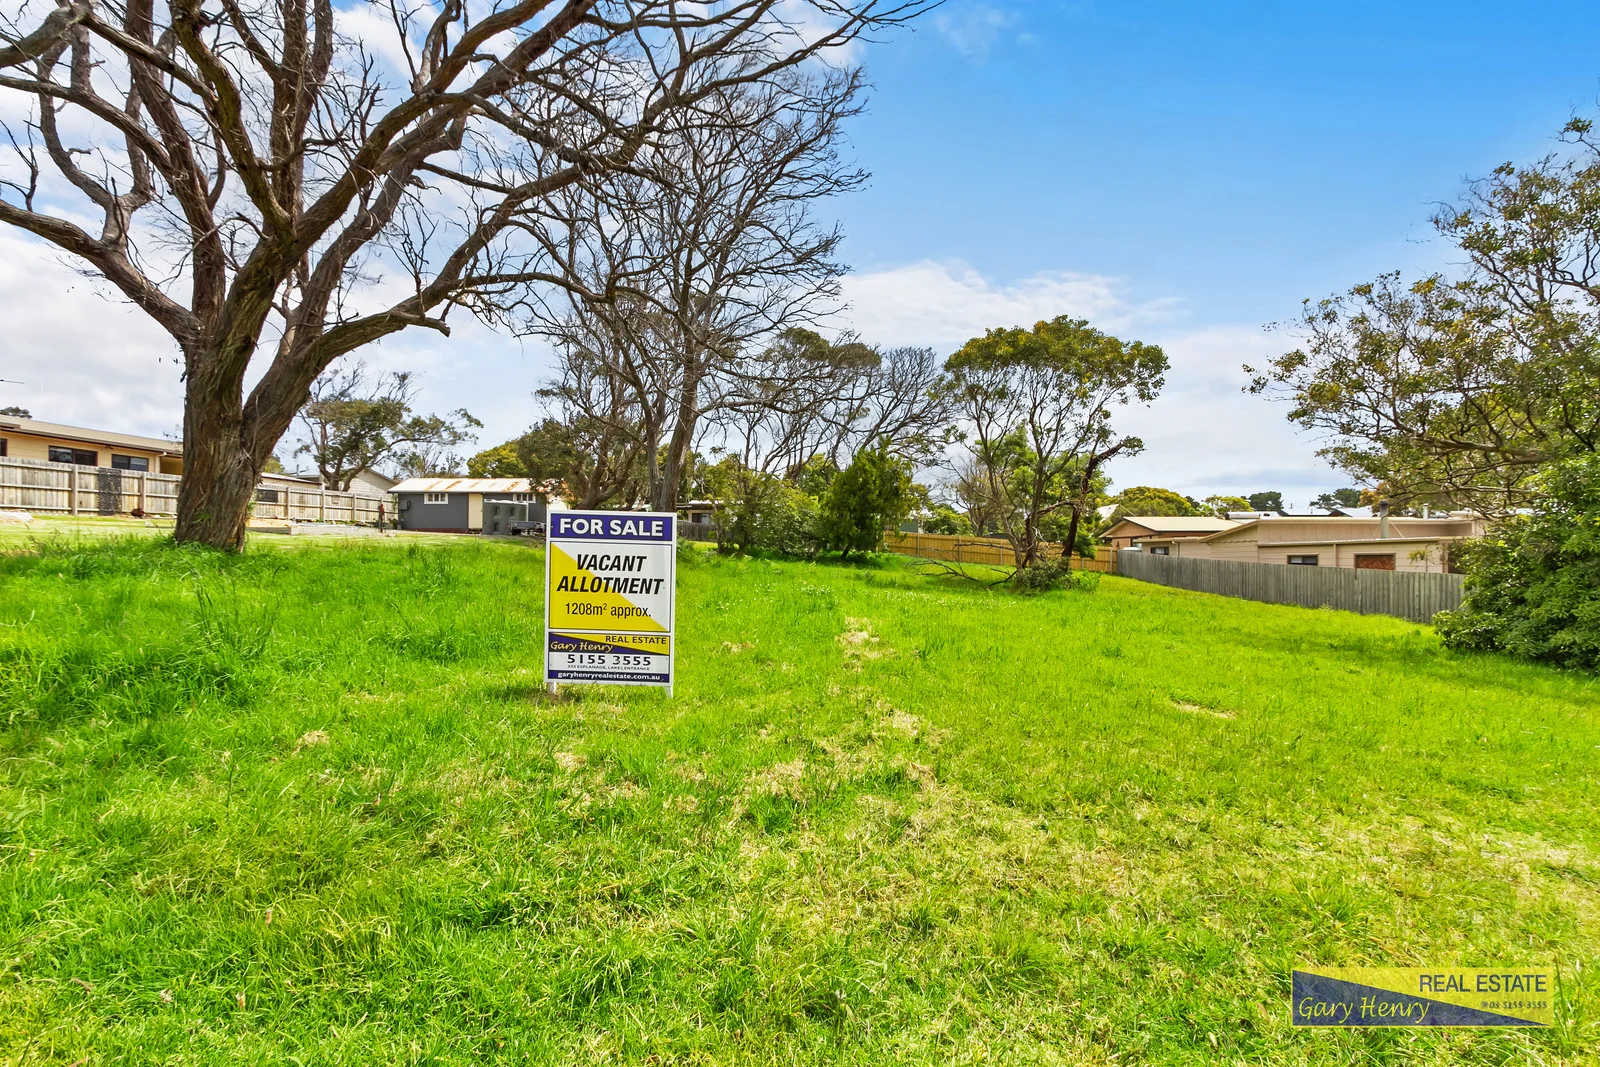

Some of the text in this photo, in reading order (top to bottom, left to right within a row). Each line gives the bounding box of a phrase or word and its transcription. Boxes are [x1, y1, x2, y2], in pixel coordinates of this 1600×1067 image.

[559, 518, 664, 537] FOR SALE
[576, 553, 648, 572] VACANT
[556, 575, 665, 595] ALLOTMENT
[610, 606, 652, 619] approx.
[605, 635, 667, 645] REAL ESTATE
[550, 640, 614, 654] Gary Henry
[567, 654, 652, 667] 5155 3555
[557, 672, 660, 680] garyhenryrealestate.com.au
